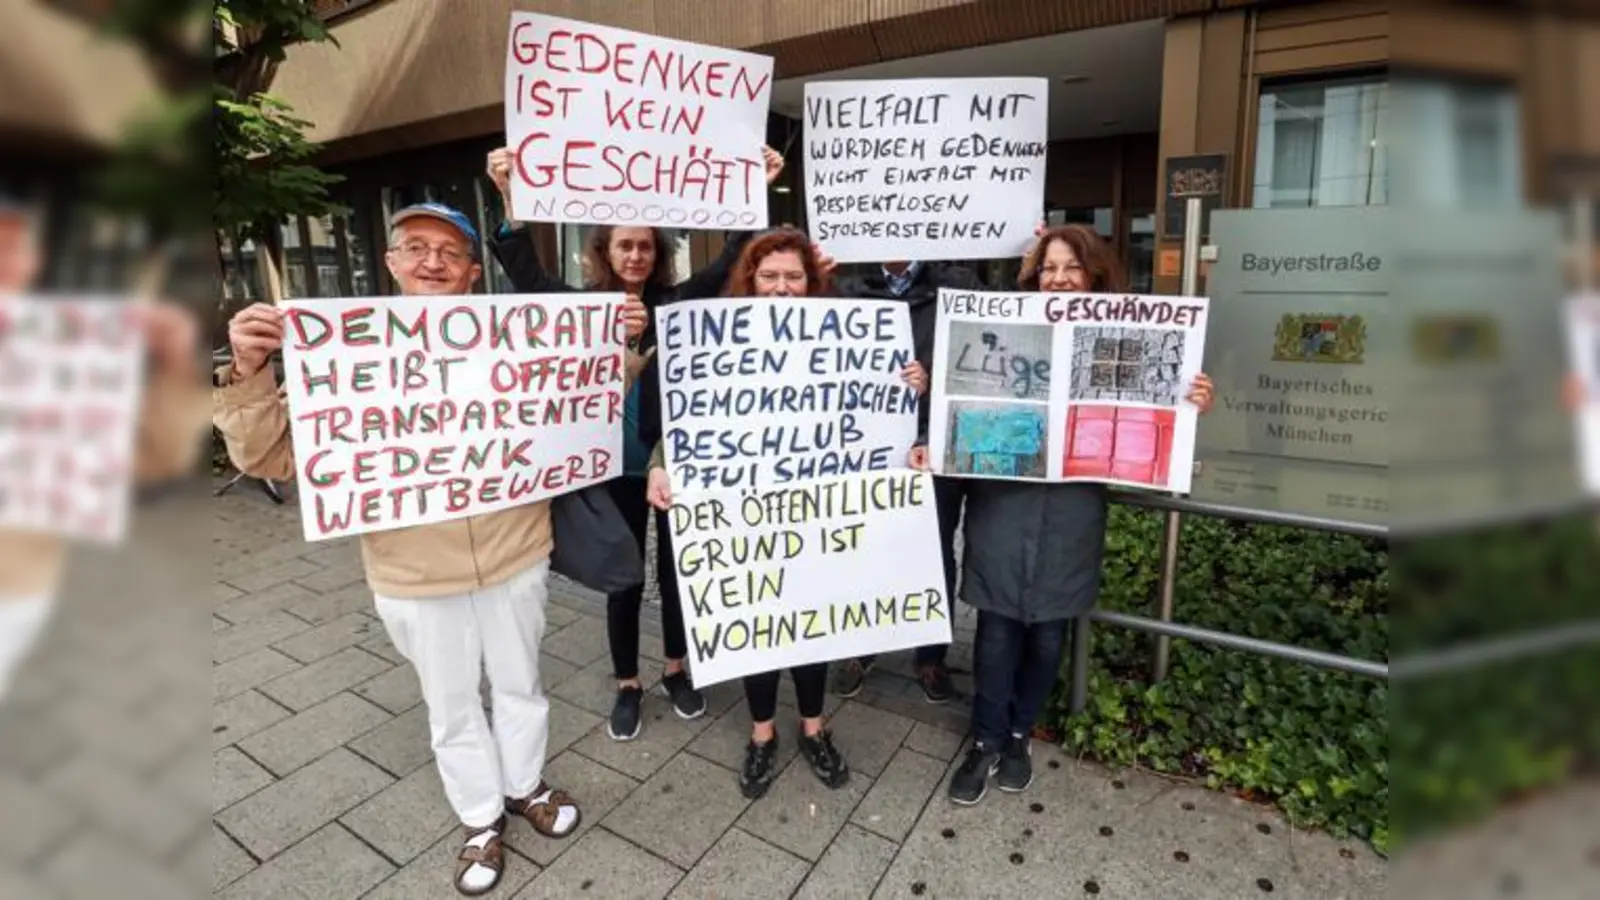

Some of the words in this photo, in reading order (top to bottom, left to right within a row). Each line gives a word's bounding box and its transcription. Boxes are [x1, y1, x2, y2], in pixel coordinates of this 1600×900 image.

[512, 22, 769, 102] GEDENKEN
[516, 74, 582, 119] IST
[605, 89, 704, 136] KEIN
[806, 94, 950, 129] VIELFALT
[969, 94, 1036, 122] MIT
[515, 132, 761, 204] GESCHÄFT
[810, 136, 926, 160] WÜRDIGEM
[813, 169, 869, 187] NICHT
[884, 165, 976, 185] EINFALT
[989, 165, 1031, 183] MIT
[814, 194, 969, 216] RESPEKTLOSEN
[818, 221, 1007, 241] STOLPERSTEINEN
[1241, 252, 1381, 276] Bayerstraße
[288, 302, 625, 351] DEMOKRATIE
[665, 304, 752, 350] EINE
[769, 304, 896, 342] KLAGE
[942, 293, 1031, 318] VERLEGT
[1045, 297, 1204, 327] GESCHÄNDET
[491, 353, 623, 394] OFFENER
[665, 349, 788, 383] GEGEN
[809, 347, 909, 375] EINEN
[955, 331, 1050, 399] Lüge
[1257, 374, 1373, 395] Bayerisches
[298, 391, 624, 446] TRANSPARENTER
[666, 380, 918, 422] DEMOKRATISCHEN
[1266, 423, 1353, 444] München
[304, 438, 534, 489] GEDENK
[773, 446, 894, 483] SHANE
[315, 448, 611, 534] WETTBEWERB
[668, 499, 731, 536] DER
[741, 473, 923, 527] ÖFFENTLICHE
[678, 530, 804, 578] GRUND
[821, 523, 865, 554] IST
[689, 567, 785, 618] KEIN
[691, 588, 946, 663] WOHNZIMMER
